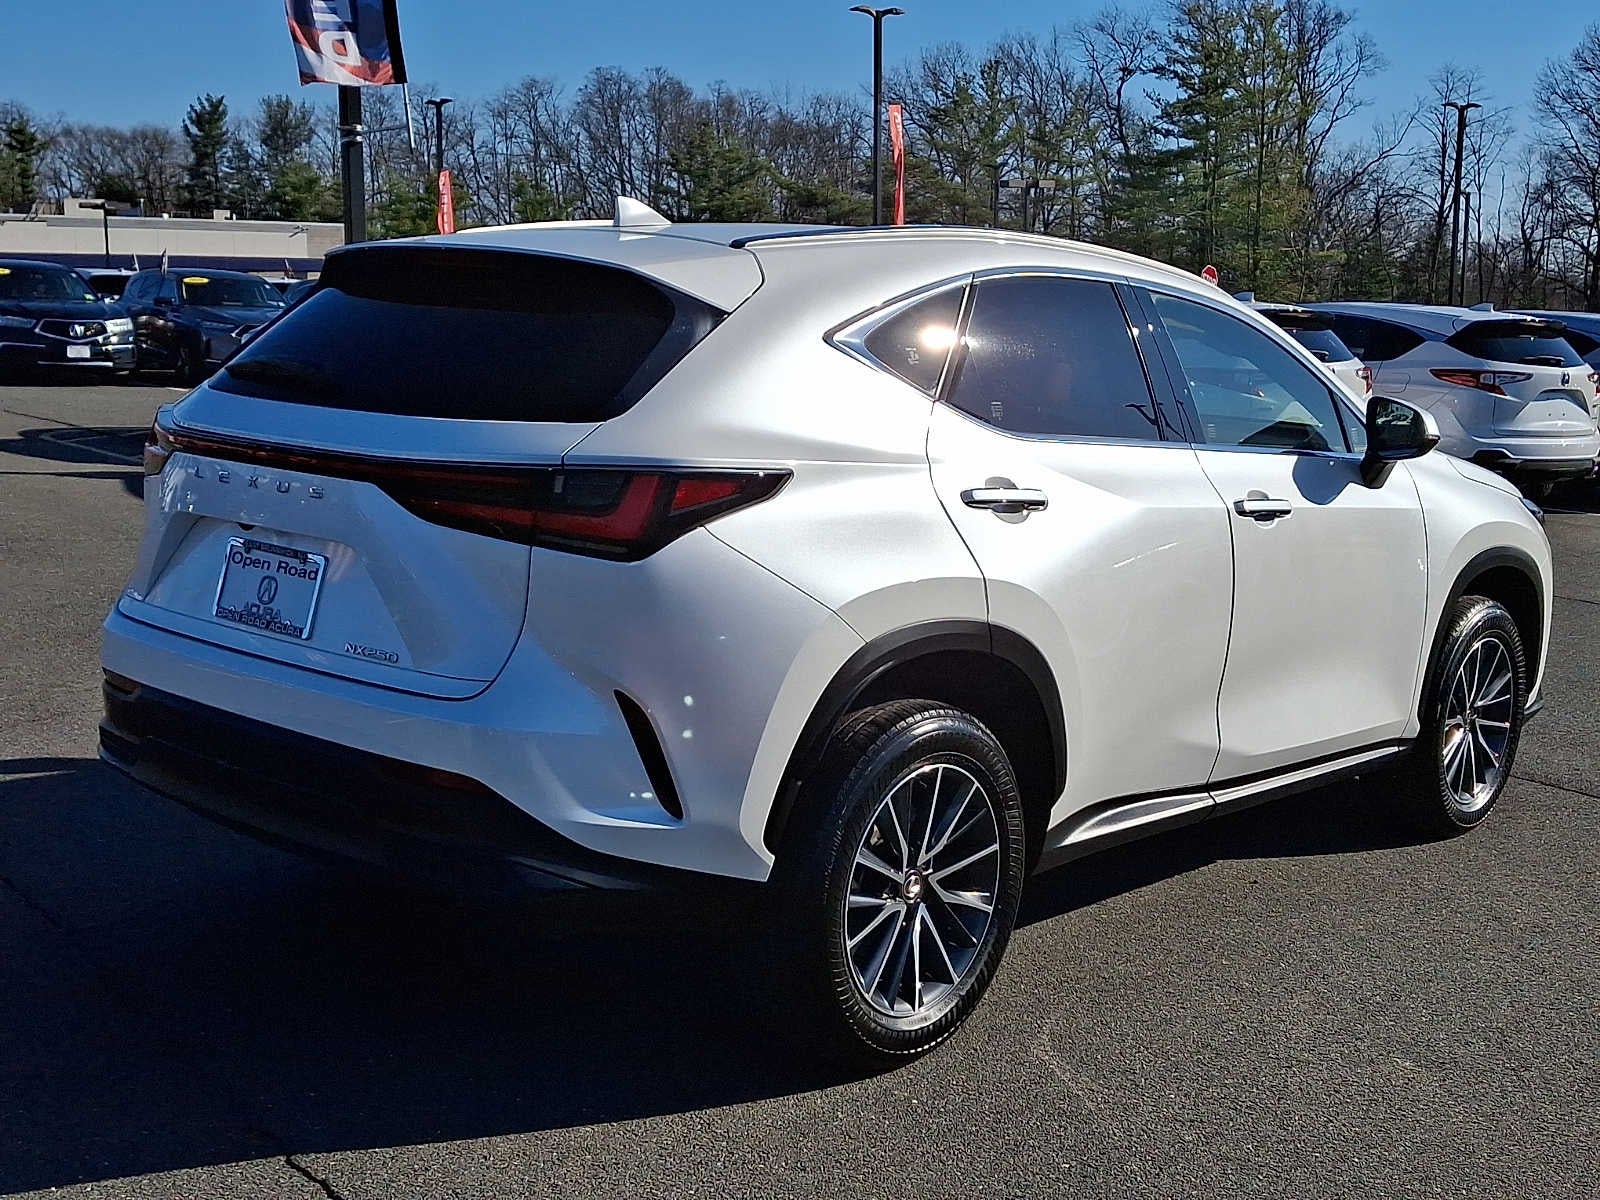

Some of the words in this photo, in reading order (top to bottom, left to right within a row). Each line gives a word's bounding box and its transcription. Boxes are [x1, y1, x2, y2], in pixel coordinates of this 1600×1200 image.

[194, 466, 324, 499] LEXUS
[231, 551, 271, 570] Open
[276, 560, 319, 580] Road
[217, 608, 240, 620] OPEN
[242, 614, 267, 627] ROAD
[267, 621, 300, 636] ACURA
